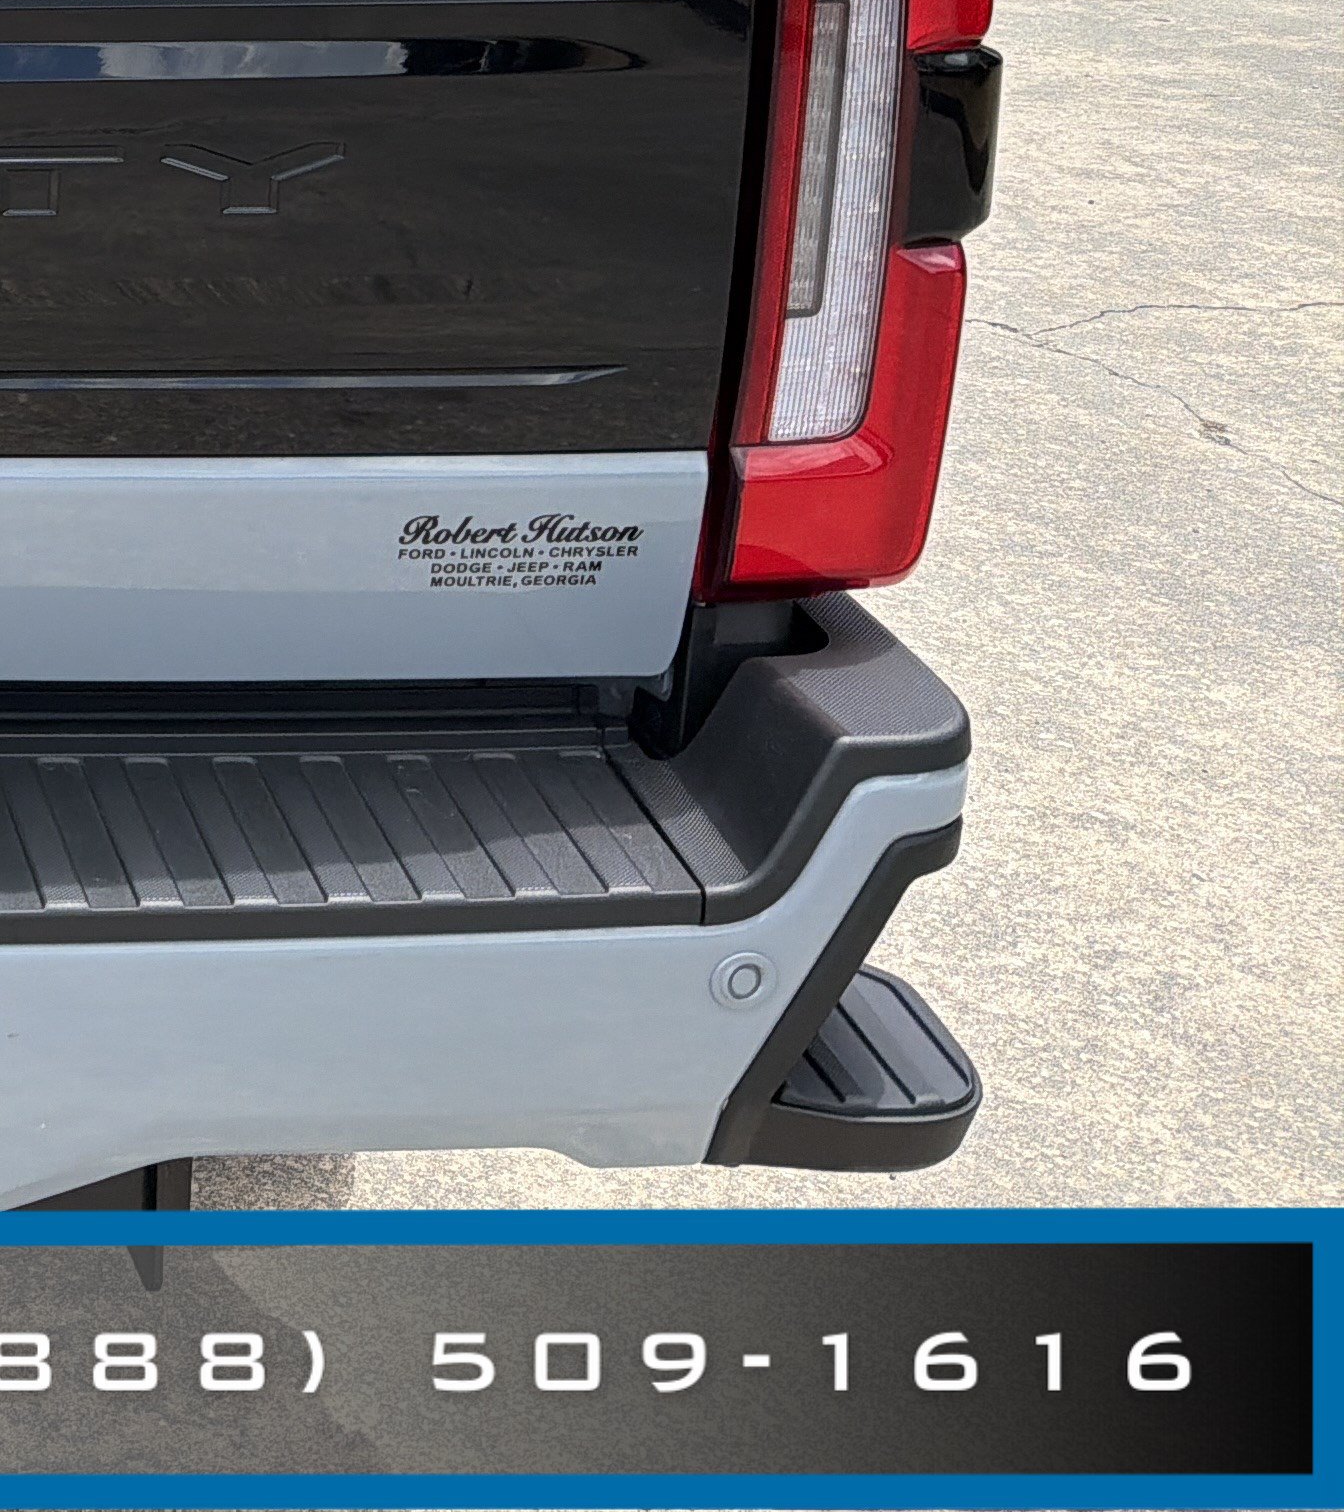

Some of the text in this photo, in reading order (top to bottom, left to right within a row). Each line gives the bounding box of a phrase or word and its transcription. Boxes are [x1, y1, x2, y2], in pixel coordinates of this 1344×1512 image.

[398, 513, 645, 545] Robert Hutson
[398, 545, 639, 560] FORD LINCOLN CHRYSLER
[430, 561, 603, 574] DODGE JEEP RAM
[429, 574, 598, 589] MOULTRIE, GEORGIA
